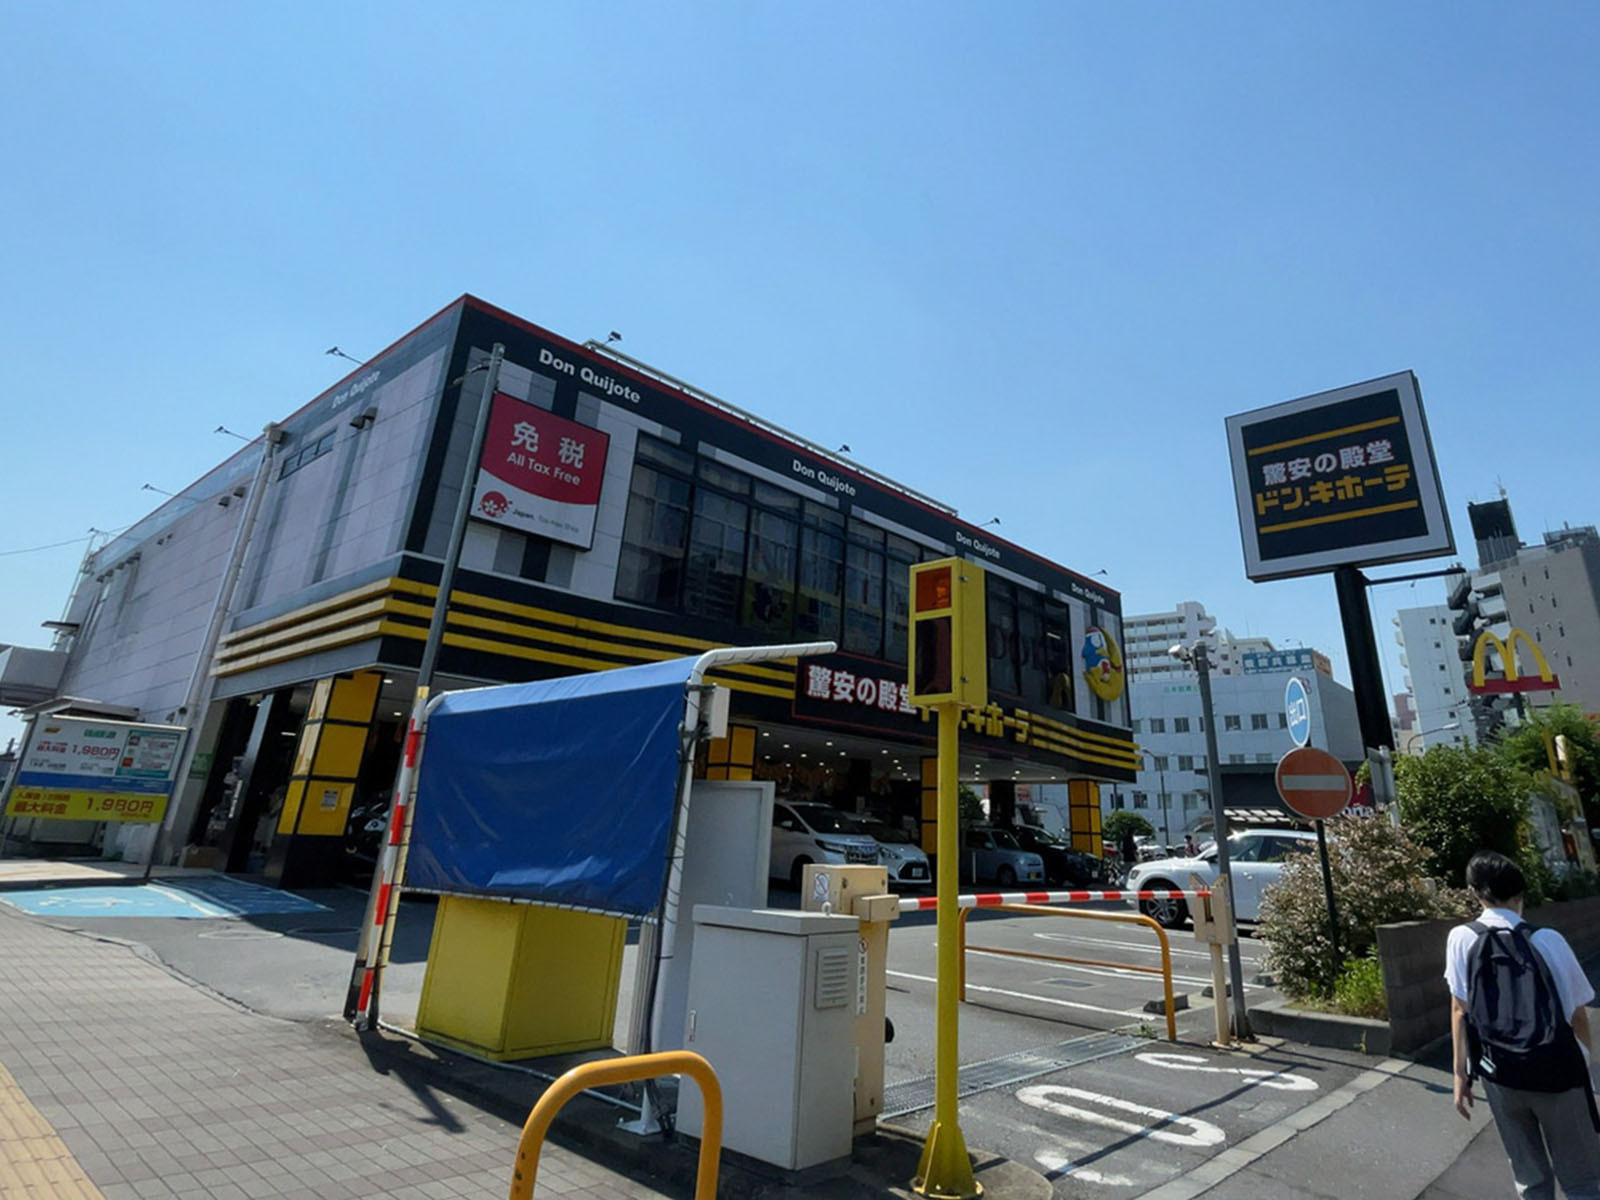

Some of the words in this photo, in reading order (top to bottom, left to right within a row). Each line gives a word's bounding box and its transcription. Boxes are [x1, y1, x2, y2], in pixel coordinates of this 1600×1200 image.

[539, 348, 575, 376] Don
[580, 367, 640, 403] Quijote
[507, 452, 525, 467] All
[528, 457, 551, 476] Tax
[553, 466, 581, 486] Free
[792, 459, 816, 479] Don
[817, 471, 856, 496] Quijote
[1262, 439, 1395, 486] 驚安の殿堂
[956, 531, 972, 547] Don
[973, 538, 1001, 559] Quijote
